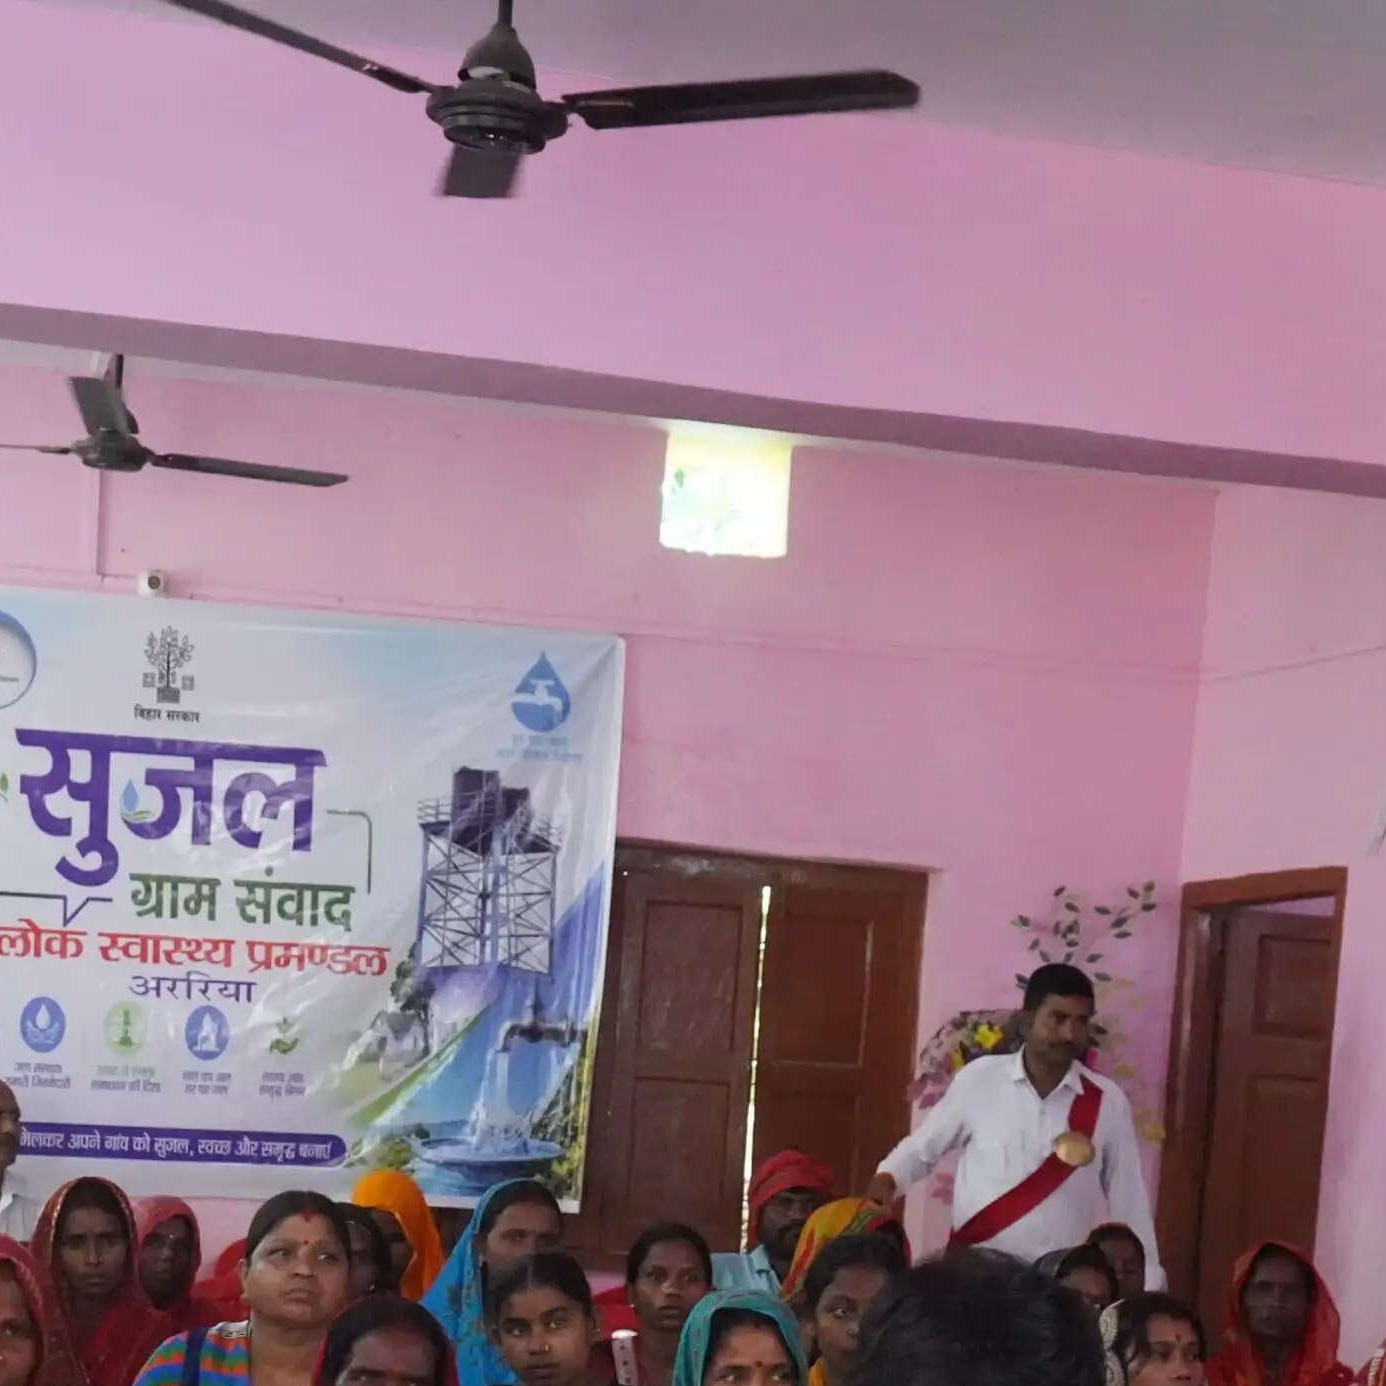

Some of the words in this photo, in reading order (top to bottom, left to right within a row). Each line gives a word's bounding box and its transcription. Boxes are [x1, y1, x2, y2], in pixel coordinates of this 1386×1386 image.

[134, 703, 161, 721] बिहार
[166, 709, 200, 723] सरकार
[15, 728, 327, 887] सुजल
[129, 873, 220, 922] ग्राम
[233, 866, 356, 932] संवाद
[98, 932, 235, 969] स्वास्थ्य
[246, 940, 391, 977] प्रमण्डल
[128, 971, 259, 1003] अररिया
[67, 1128, 101, 1150] अपने
[104, 1133, 129, 1151] गांव
[132, 1131, 151, 1152] को
[154, 1137, 194, 1158] सुजल,
[198, 1139, 231, 1155] स्वच्छ
[234, 1135, 259, 1157] और
[261, 1141, 296, 1162] समृद्ध
